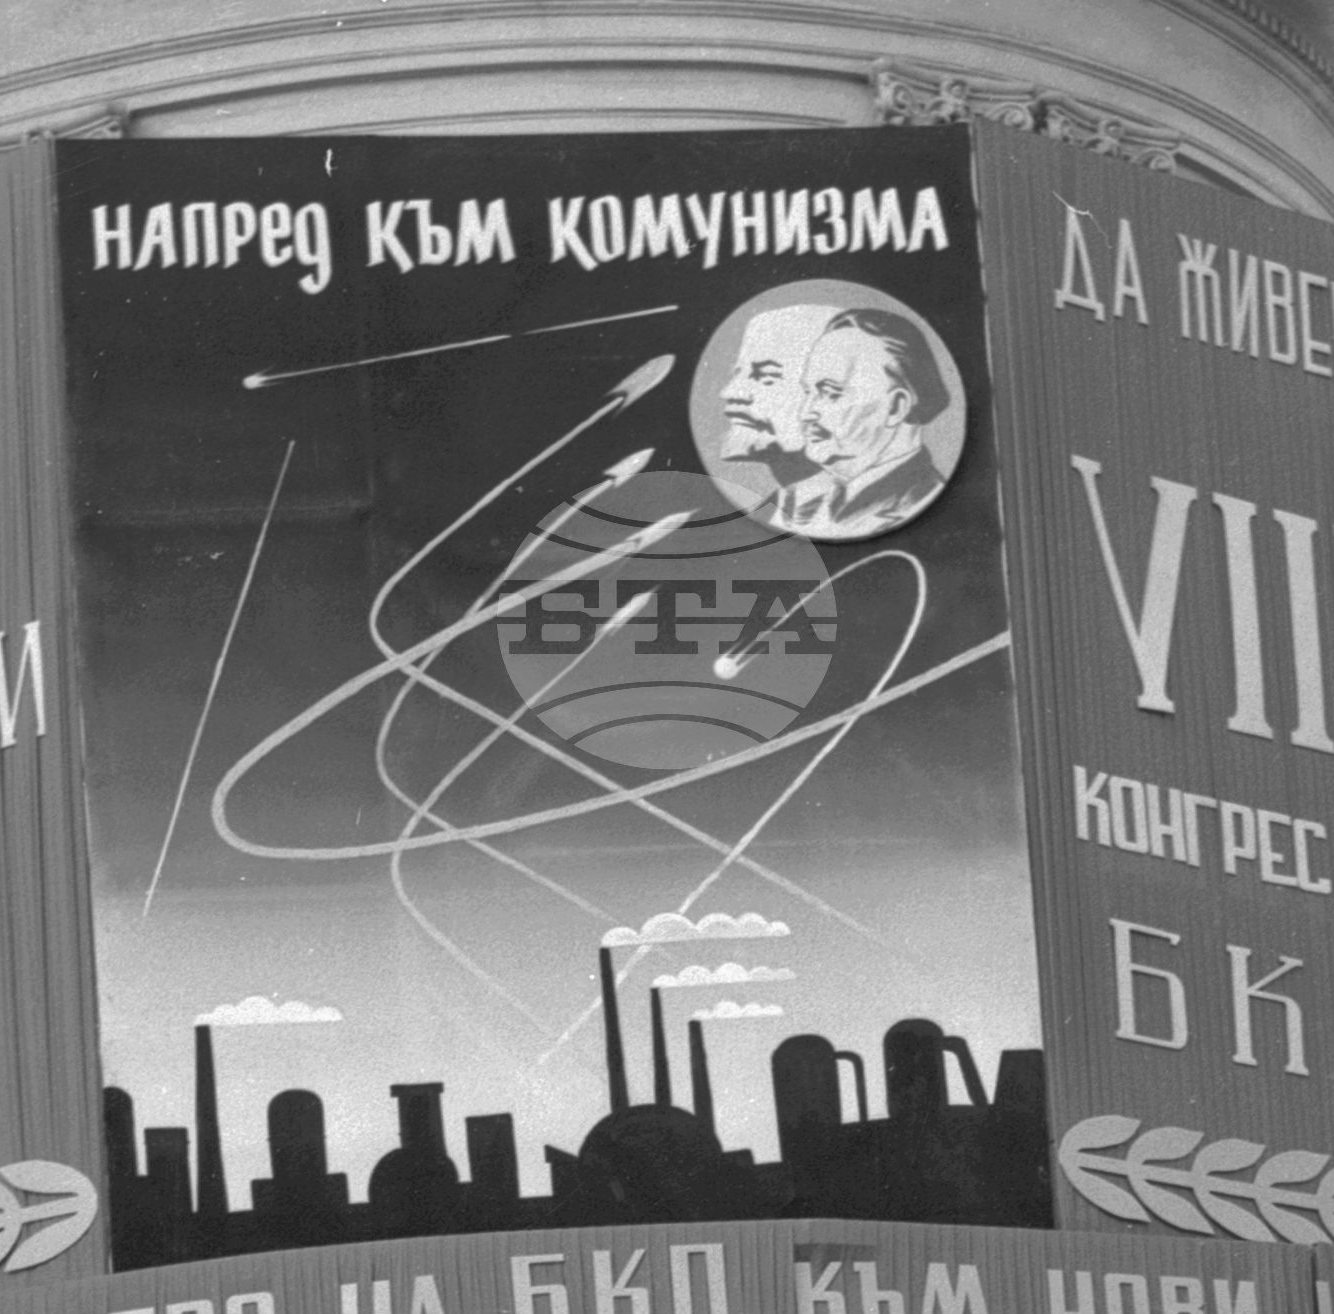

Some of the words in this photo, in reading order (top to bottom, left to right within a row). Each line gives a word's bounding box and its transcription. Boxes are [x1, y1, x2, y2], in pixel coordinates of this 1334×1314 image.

[367, 198, 516, 273] КЪМ
[549, 187, 949, 271] КОМУНИЗМА
[1055, 205, 1148, 324] ДА
[1073, 765, 1331, 894] КОНГРЕС
